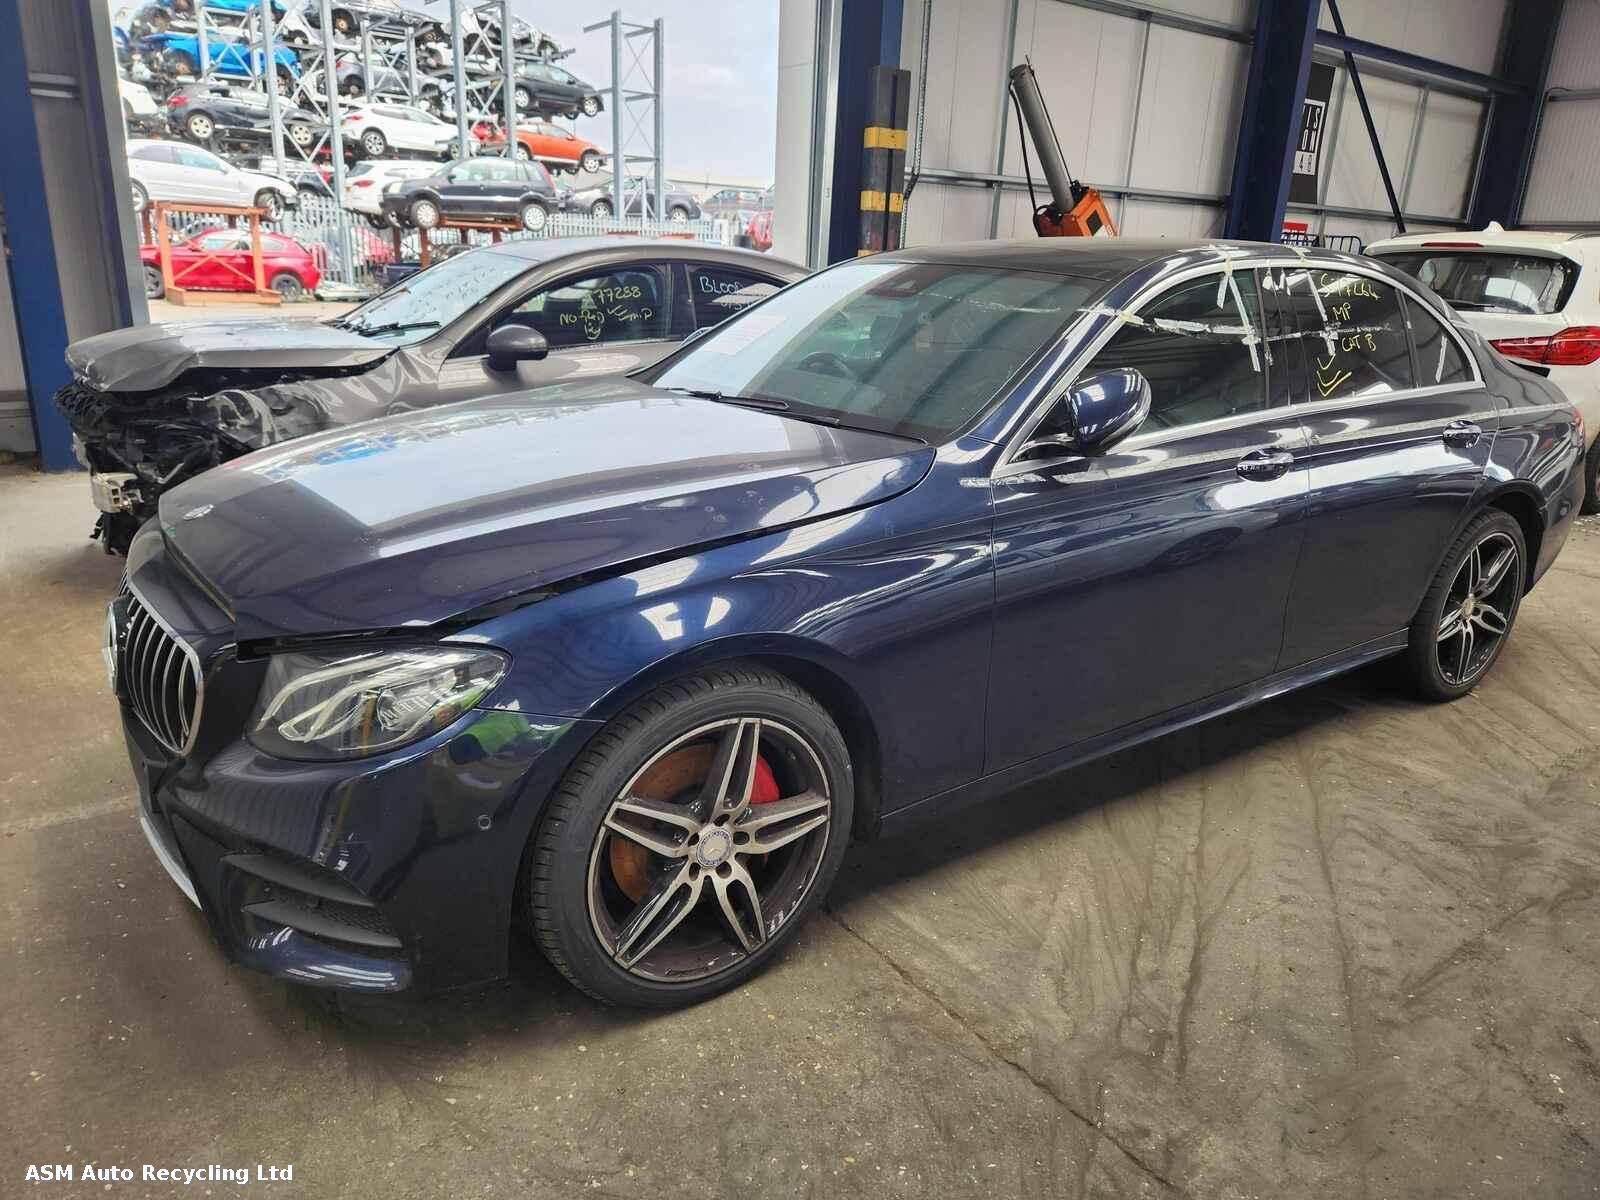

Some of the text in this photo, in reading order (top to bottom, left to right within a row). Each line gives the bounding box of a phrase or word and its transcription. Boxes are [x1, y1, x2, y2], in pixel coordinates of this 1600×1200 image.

[1332, 302, 1351, 321] MP
[1341, 333, 1377, 352] CAT B
